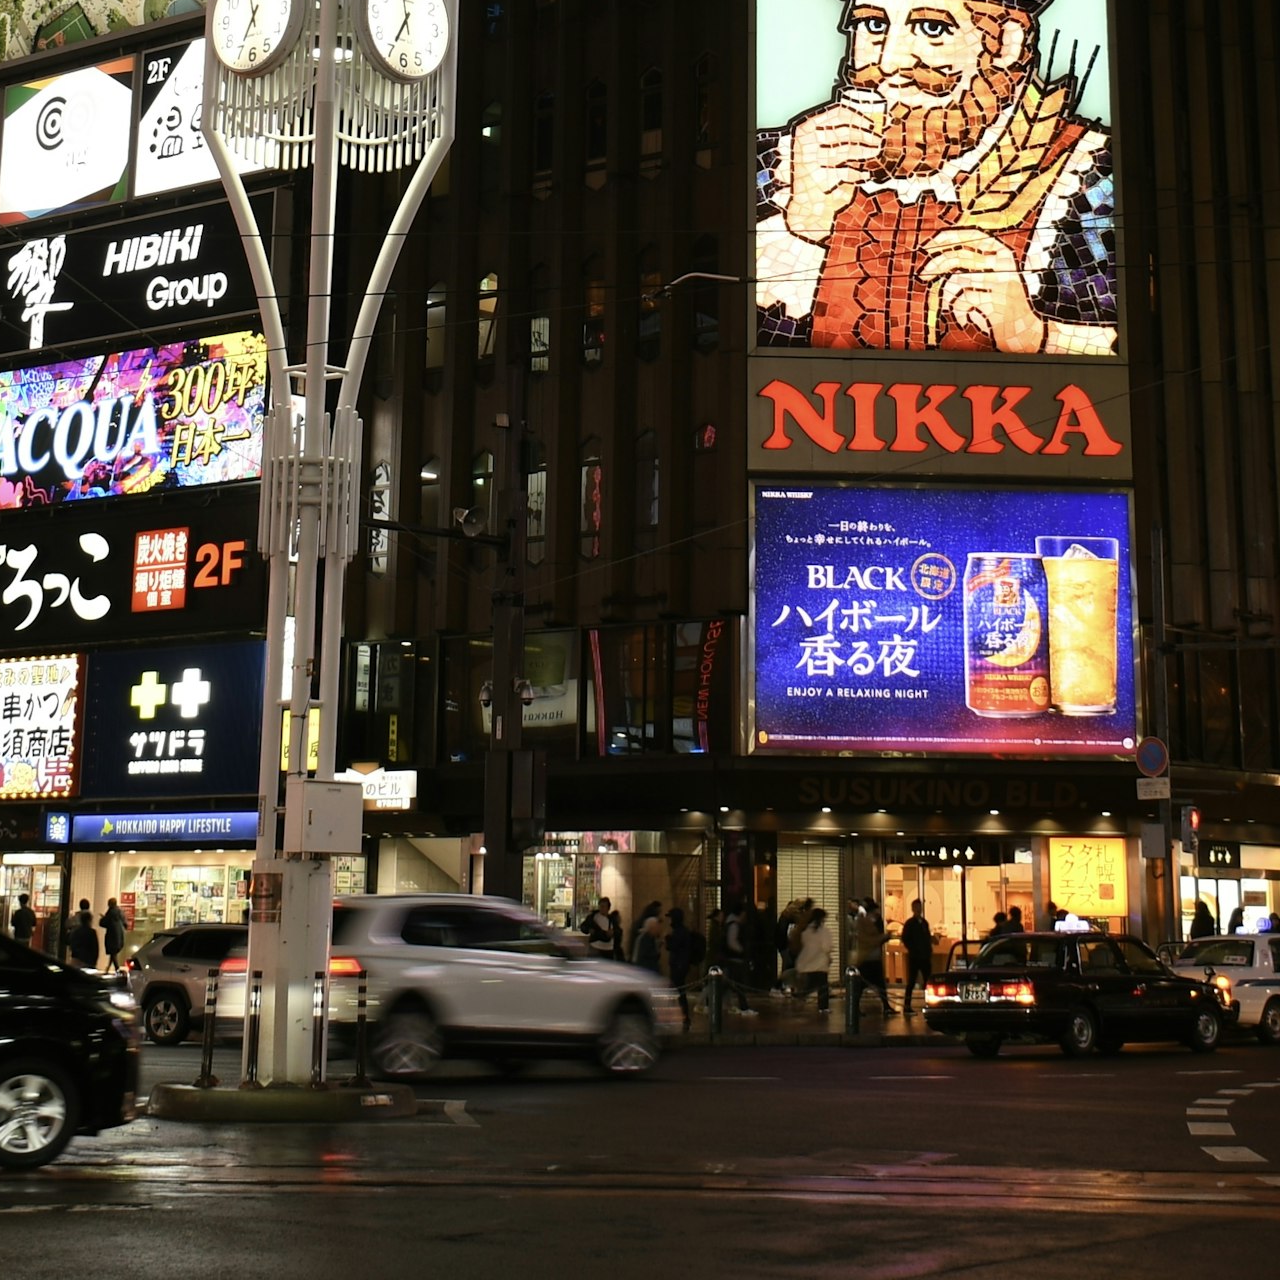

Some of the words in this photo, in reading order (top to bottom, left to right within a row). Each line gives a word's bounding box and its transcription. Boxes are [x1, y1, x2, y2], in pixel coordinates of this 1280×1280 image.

[147, 57, 172, 84] 2F
[103, 224, 204, 276] HIBIKI
[146, 271, 228, 311] Group
[160, 358, 260, 422] 300坪
[758, 378, 1124, 456] NIKKA
[169, 421, 252, 469] 日本一
[136, 531, 188, 564] 炭火焼き
[193, 540, 245, 588] 2F
[807, 564, 907, 591] BLACK
[771, 598, 943, 634] ハイボール
[795, 633, 921, 677] 香る夜
[786, 686, 823, 698] ENJOY
[826, 687, 834, 698] A
[836, 687, 891, 699] RELAXING
[894, 688, 929, 699] NIGHT
[129, 729, 205, 758] サツドラ
[798, 776, 991, 808] SUSUKINO
[116, 820, 157, 834] HOKKAIDO
[159, 819, 186, 833] HAPPY
[188, 817, 232, 832] LIFESTYLE
[1058, 843, 1077, 908] スクエア
[1078, 843, 1097, 908] タイムズ
[1096, 843, 1116, 882] 札幌
